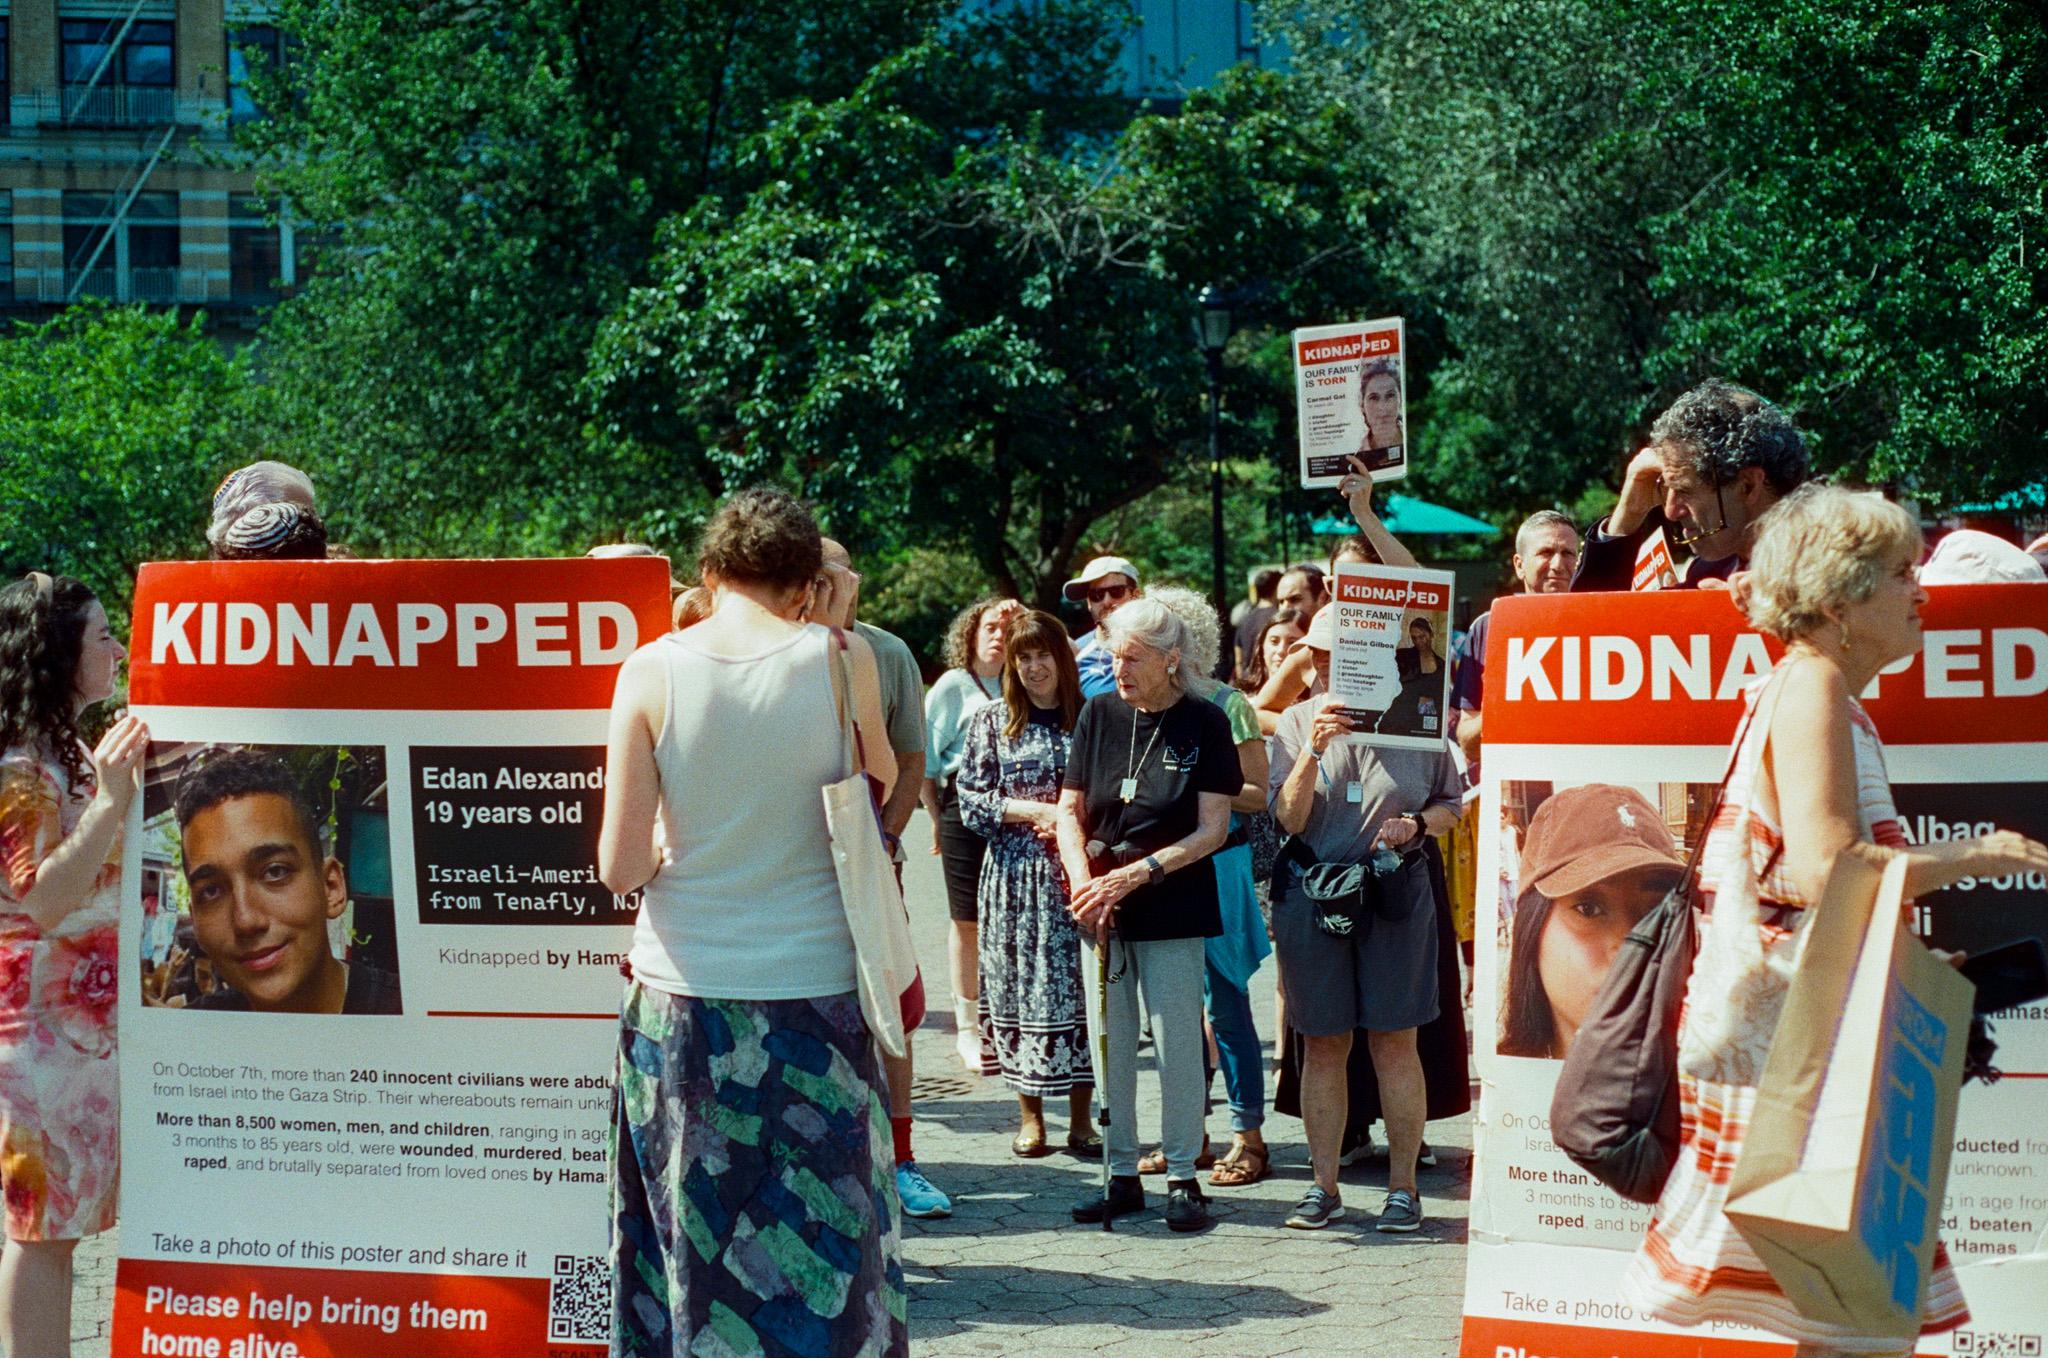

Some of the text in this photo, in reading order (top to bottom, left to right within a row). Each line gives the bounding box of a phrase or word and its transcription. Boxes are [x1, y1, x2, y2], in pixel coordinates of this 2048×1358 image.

[1305, 339, 1390, 360] KIDNAPPED
[1305, 364, 1360, 378] OUR FAMILY
[1305, 376, 1346, 388] IS TORN
[1343, 584, 1439, 604] KIDNAPPED
[1340, 618, 1386, 630] IS TORN
[1341, 608, 1402, 622] OUR FAMILY
[150, 601, 639, 667] KIDNAPPED
[1339, 638, 1394, 648] Daniela Gilboa
[1505, 627, 2048, 701] KIDNAED
[422, 767, 606, 790] Edan Alexand
[424, 801, 582, 829] 19 years old
[428, 865, 598, 884] Israeli-Ameri
[429, 891, 640, 915] from Tenafly, NJ
[439, 949, 540, 968] Kidnapped
[547, 950, 570, 969] by
[152, 1062, 612, 1089] On October 7th, more than 240 innocent civilians were abdu
[153, 1082, 184, 1098] from
[189, 1084, 227, 1099] Israel
[232, 1085, 258, 1101] into
[262, 1086, 285, 1101] the
[289, 1087, 328, 1103] Gaza
[333, 1088, 372, 1107] Strip.
[377, 1089, 413, 1105] Their
[418, 1091, 516, 1108] whereabouts
[521, 1095, 573, 1110] remain
[156, 1111, 193, 1127] More
[198, 1113, 231, 1128] than
[236, 1115, 276, 1131] 8,500
[281, 1119, 341, 1134] women,
[347, 1121, 385, 1136] men,
[390, 1121, 419, 1136] and
[424, 1122, 494, 1139] children,
[500, 1126, 558, 1143] ranging
[563, 1126, 576, 1140] in
[1502, 1112, 1523, 1129] On
[172, 1133, 607, 1163] 3 months to 85 years old, were wounded, murdered, beat
[1953, 1138, 2048, 1155] ducted fro
[184, 1156, 607, 1184] raped, and brutally separated from loved ones by Hama
[1508, 1166, 1547, 1182] More
[1553, 1170, 1588, 1186] than
[1954, 1161, 2039, 1178] unknown.
[1525, 1189, 1535, 1203] 3
[1539, 1191, 1595, 1208] months
[1601, 1195, 1615, 1209] to
[1960, 1195, 1974, 1208] in
[1980, 1197, 2013, 1213] age
[1538, 1213, 1588, 1230] raped,
[1594, 1218, 1624, 1232] and
[152, 1233, 528, 1269] Take a photo of this poster and share it
[1955, 1238, 2017, 1255] Hamas
[146, 1286, 487, 1333] Please help bring them
[1502, 1290, 1548, 1313] Take
[1555, 1300, 1568, 1315] a
[1575, 1298, 1633, 1322] photo
[142, 1327, 304, 1358] home alive.
